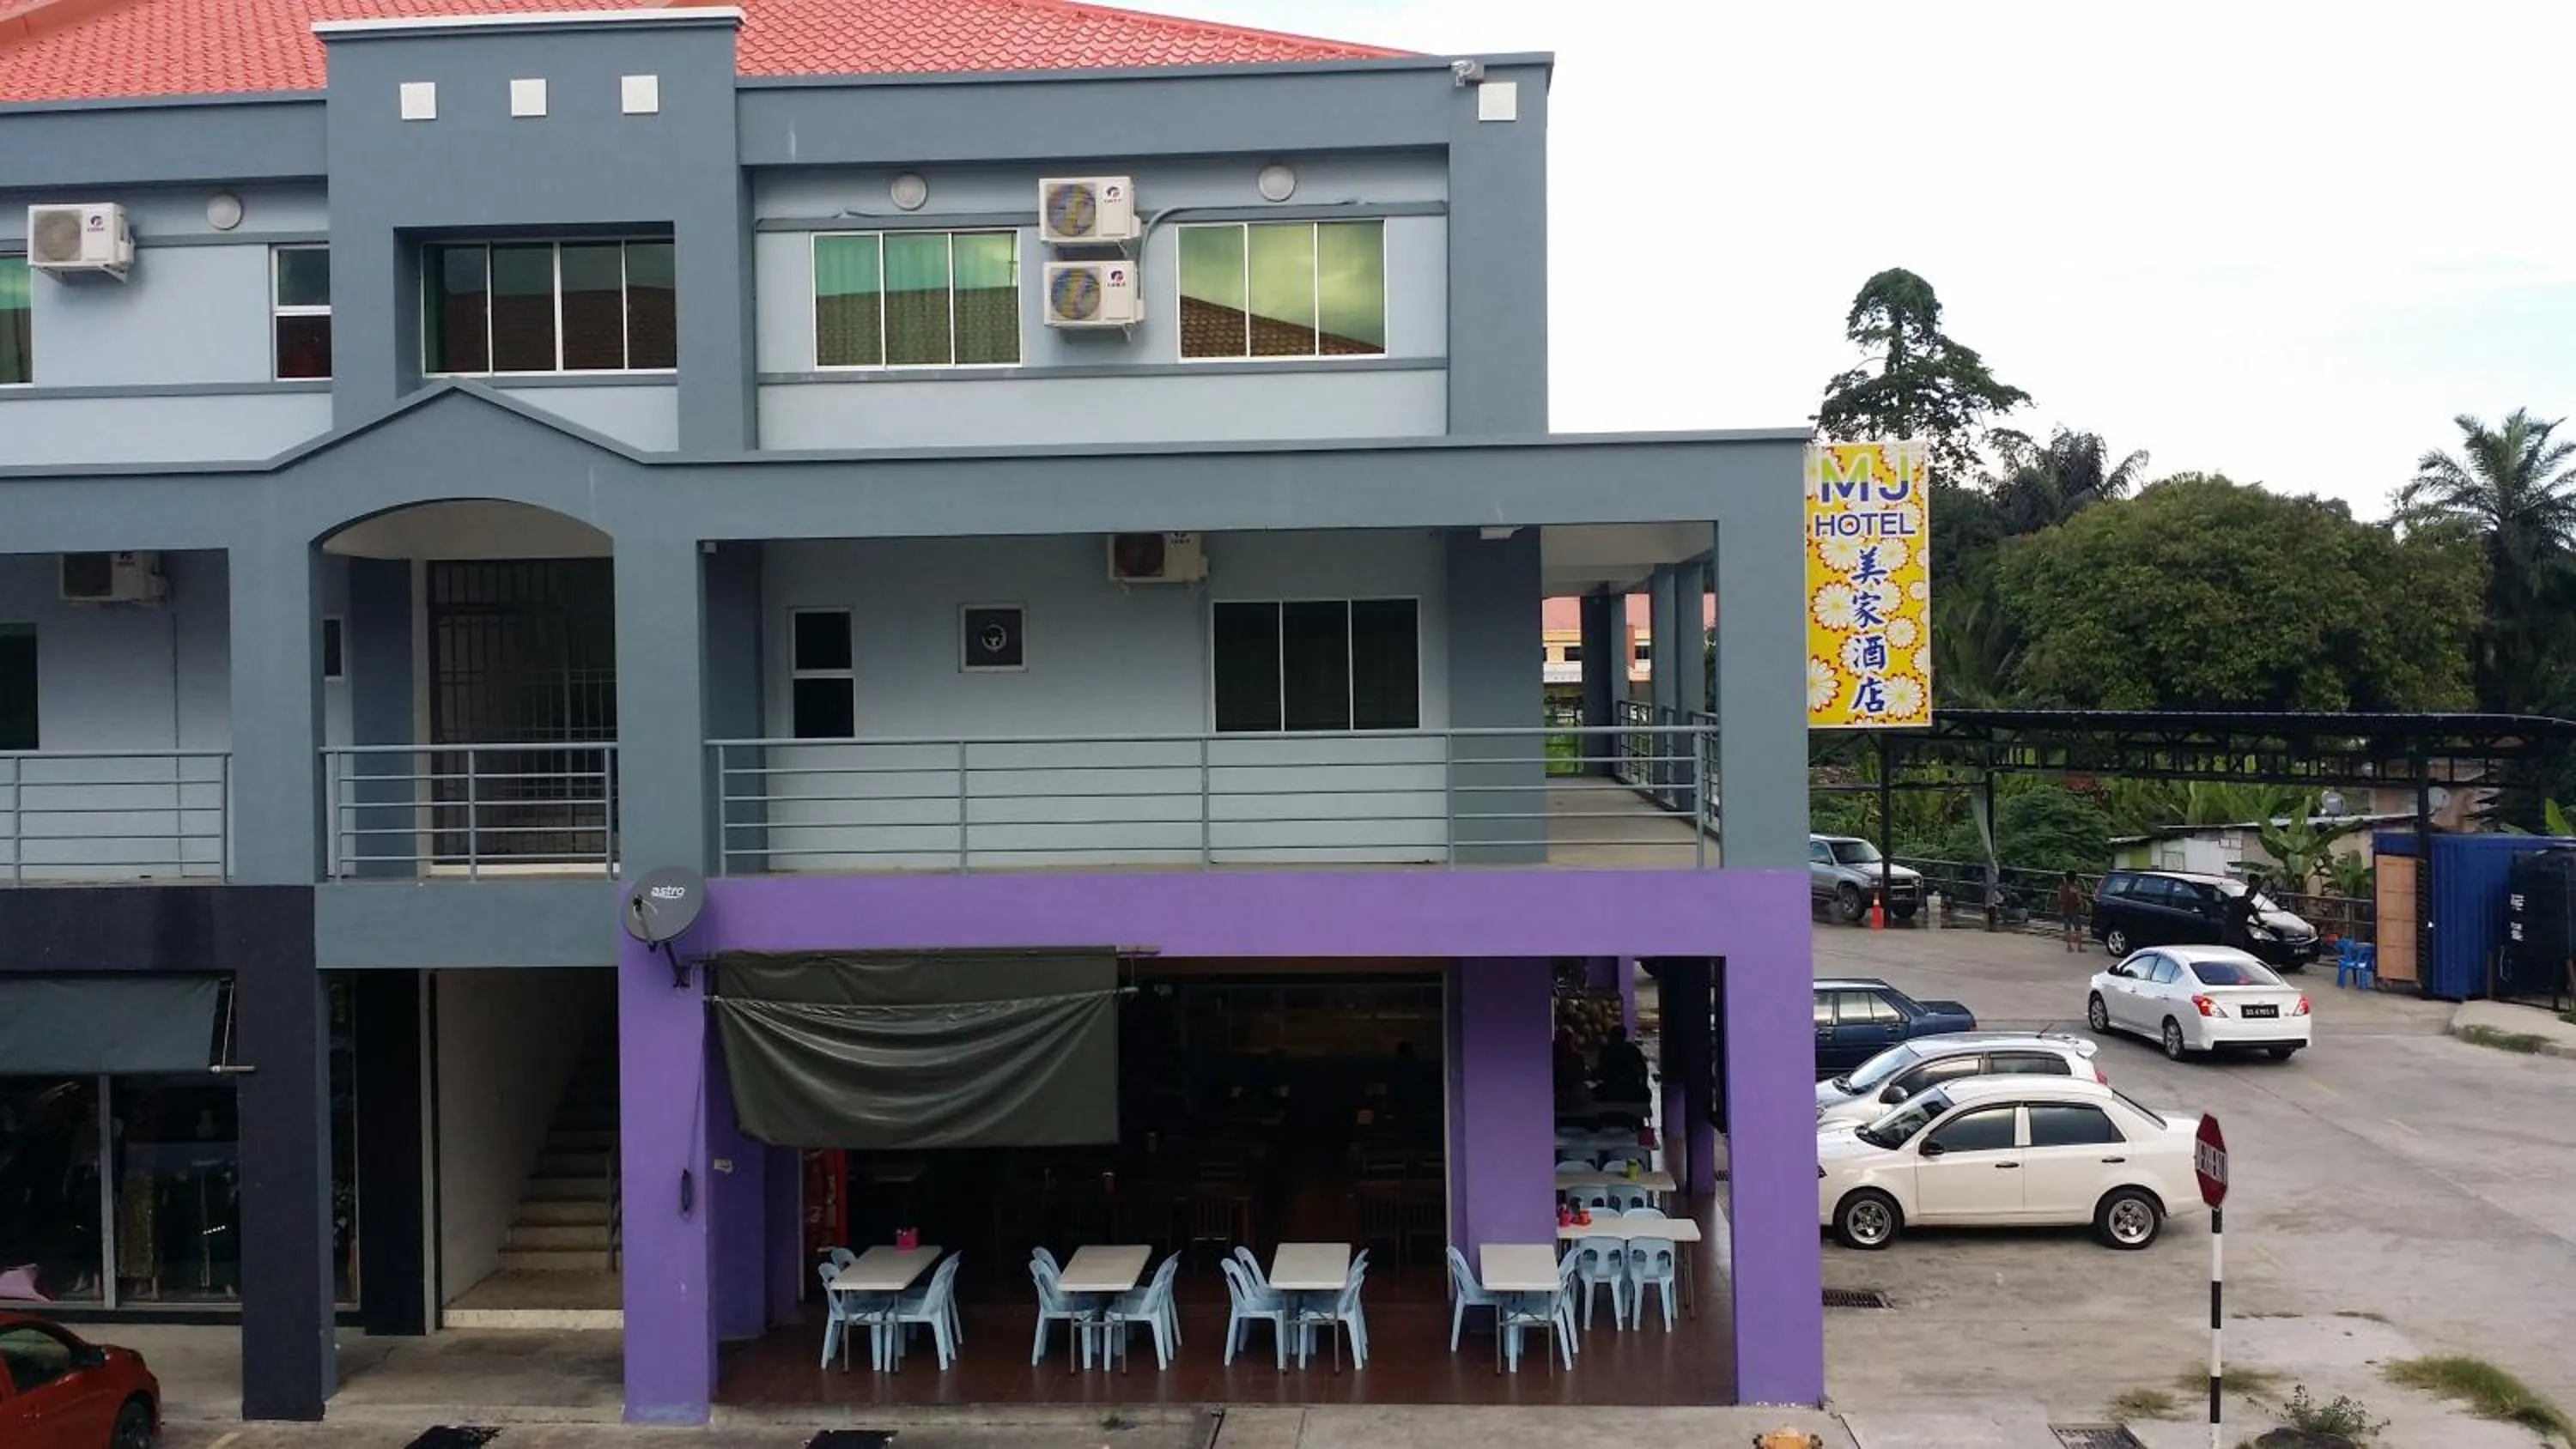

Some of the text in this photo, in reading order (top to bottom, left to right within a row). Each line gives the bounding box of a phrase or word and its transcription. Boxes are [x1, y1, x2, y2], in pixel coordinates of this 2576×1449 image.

[1821, 454, 1909, 503] MJ
[1815, 512, 1916, 537] HOTEL
[1851, 545, 1888, 713] 美家酒店
[651, 886, 684, 898] astro
